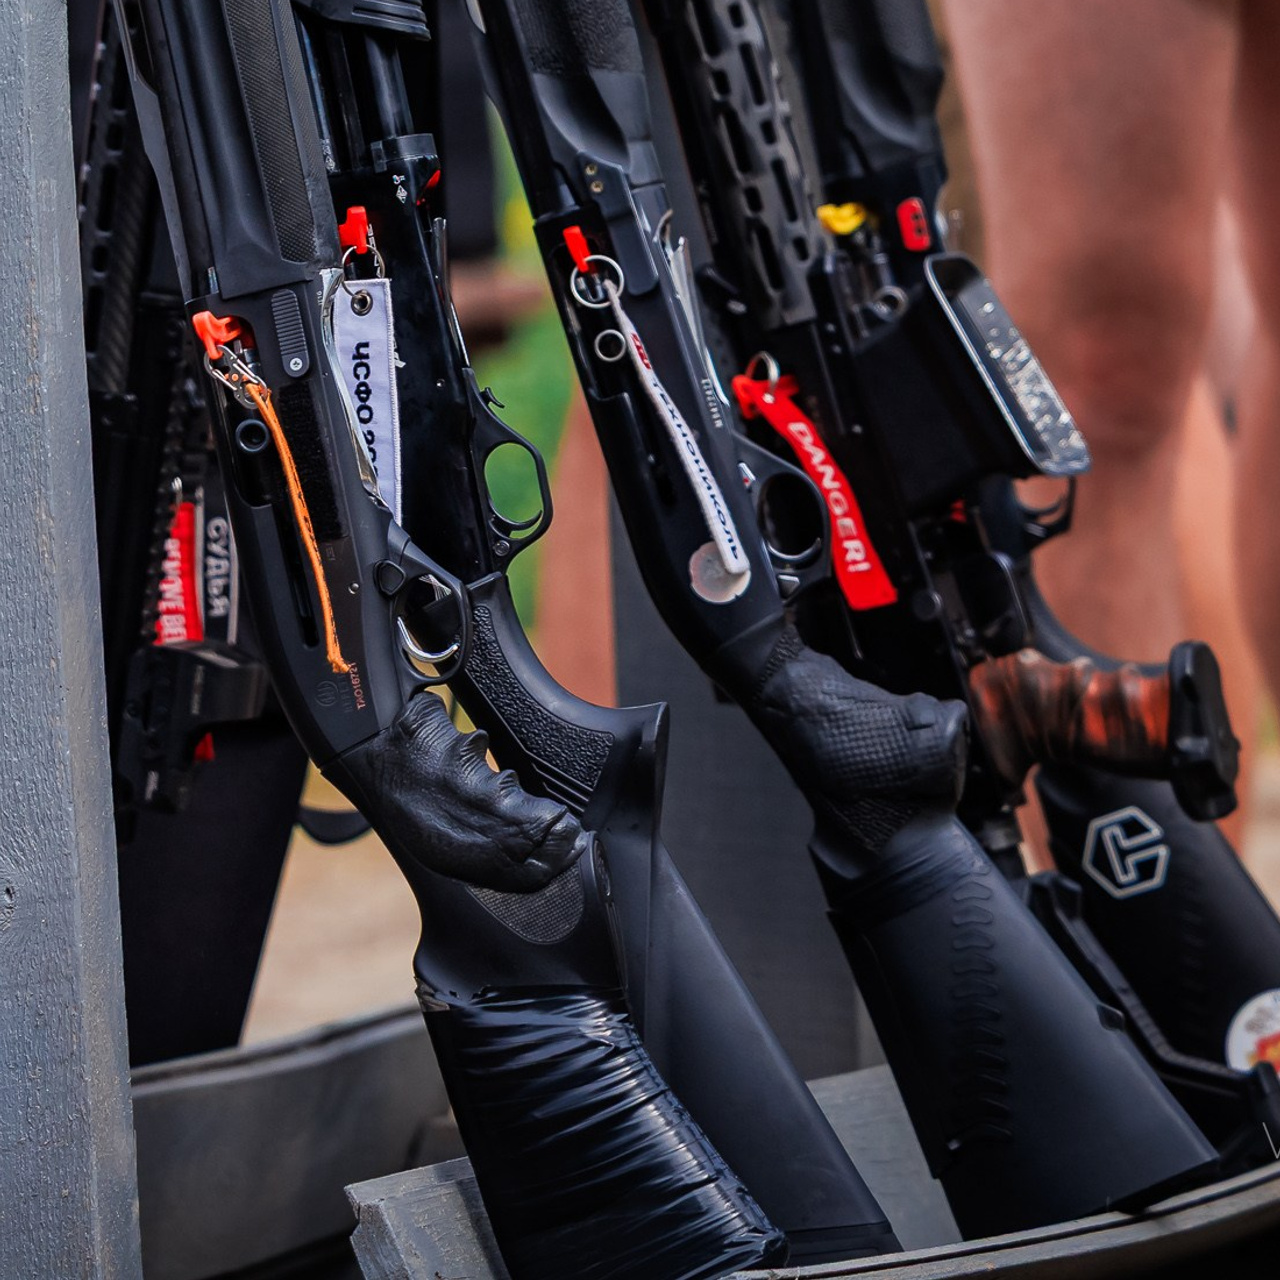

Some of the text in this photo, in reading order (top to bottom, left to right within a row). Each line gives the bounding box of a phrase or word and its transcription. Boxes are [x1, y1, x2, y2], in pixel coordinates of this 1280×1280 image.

[351, 341, 375, 425] ЧСФО
[652, 377, 739, 561] ТЕХНОНИКОЛЬ
[787, 421, 872, 573] DANGER!
